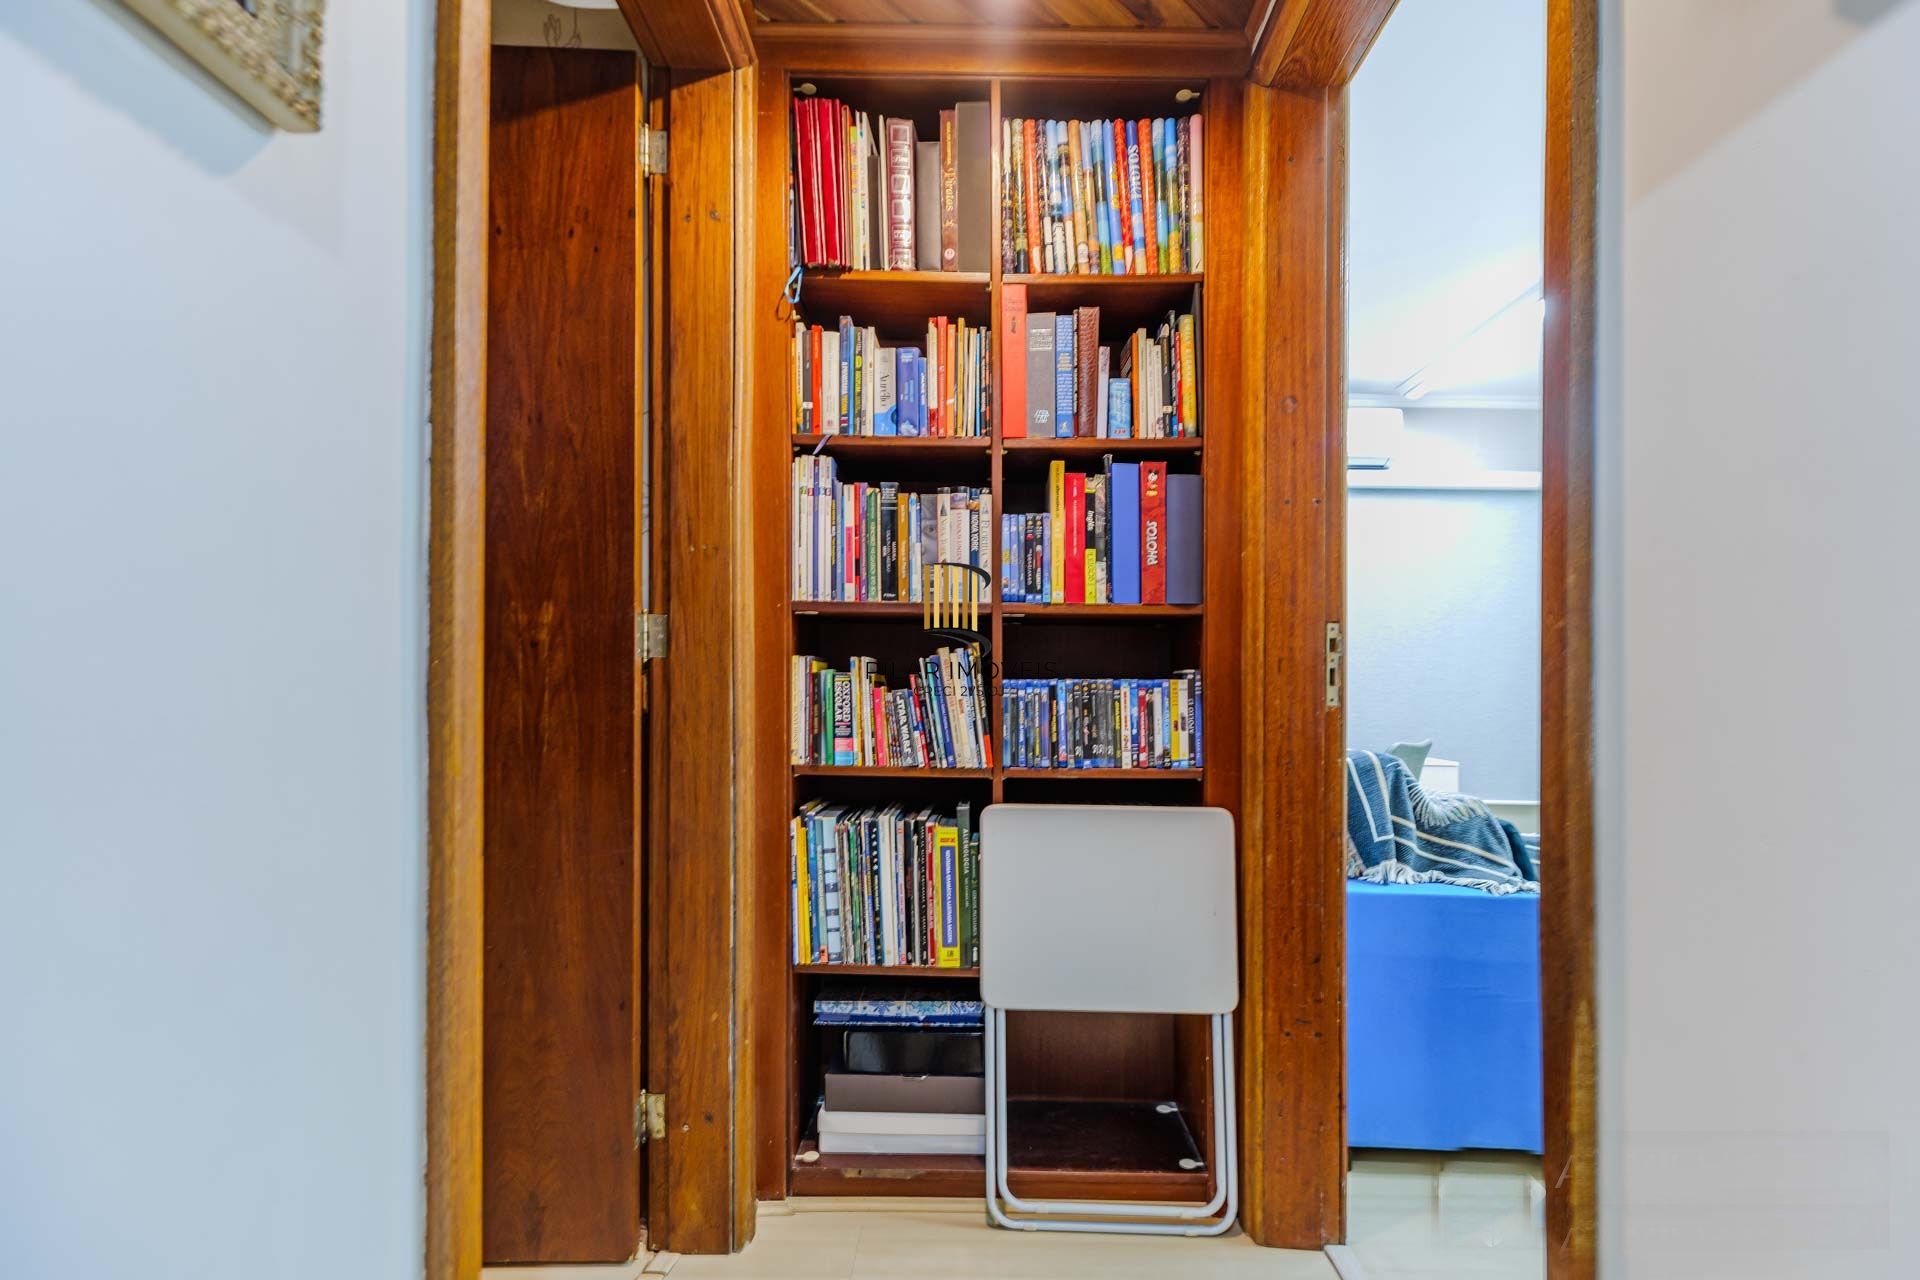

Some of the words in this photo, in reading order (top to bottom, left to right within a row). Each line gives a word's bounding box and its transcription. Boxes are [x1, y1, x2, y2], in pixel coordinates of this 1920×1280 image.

[880, 373, 891, 407] Aurélio
[970, 514, 979, 533] NOVA
[970, 533, 979, 552] YORK
[1146, 520, 1159, 566] PHOTOS
[834, 680, 843, 722] ESCOLAR
[842, 680, 851, 722] OXFORD
[896, 695, 906, 725] STAR
[901, 724, 911, 754] WARS
